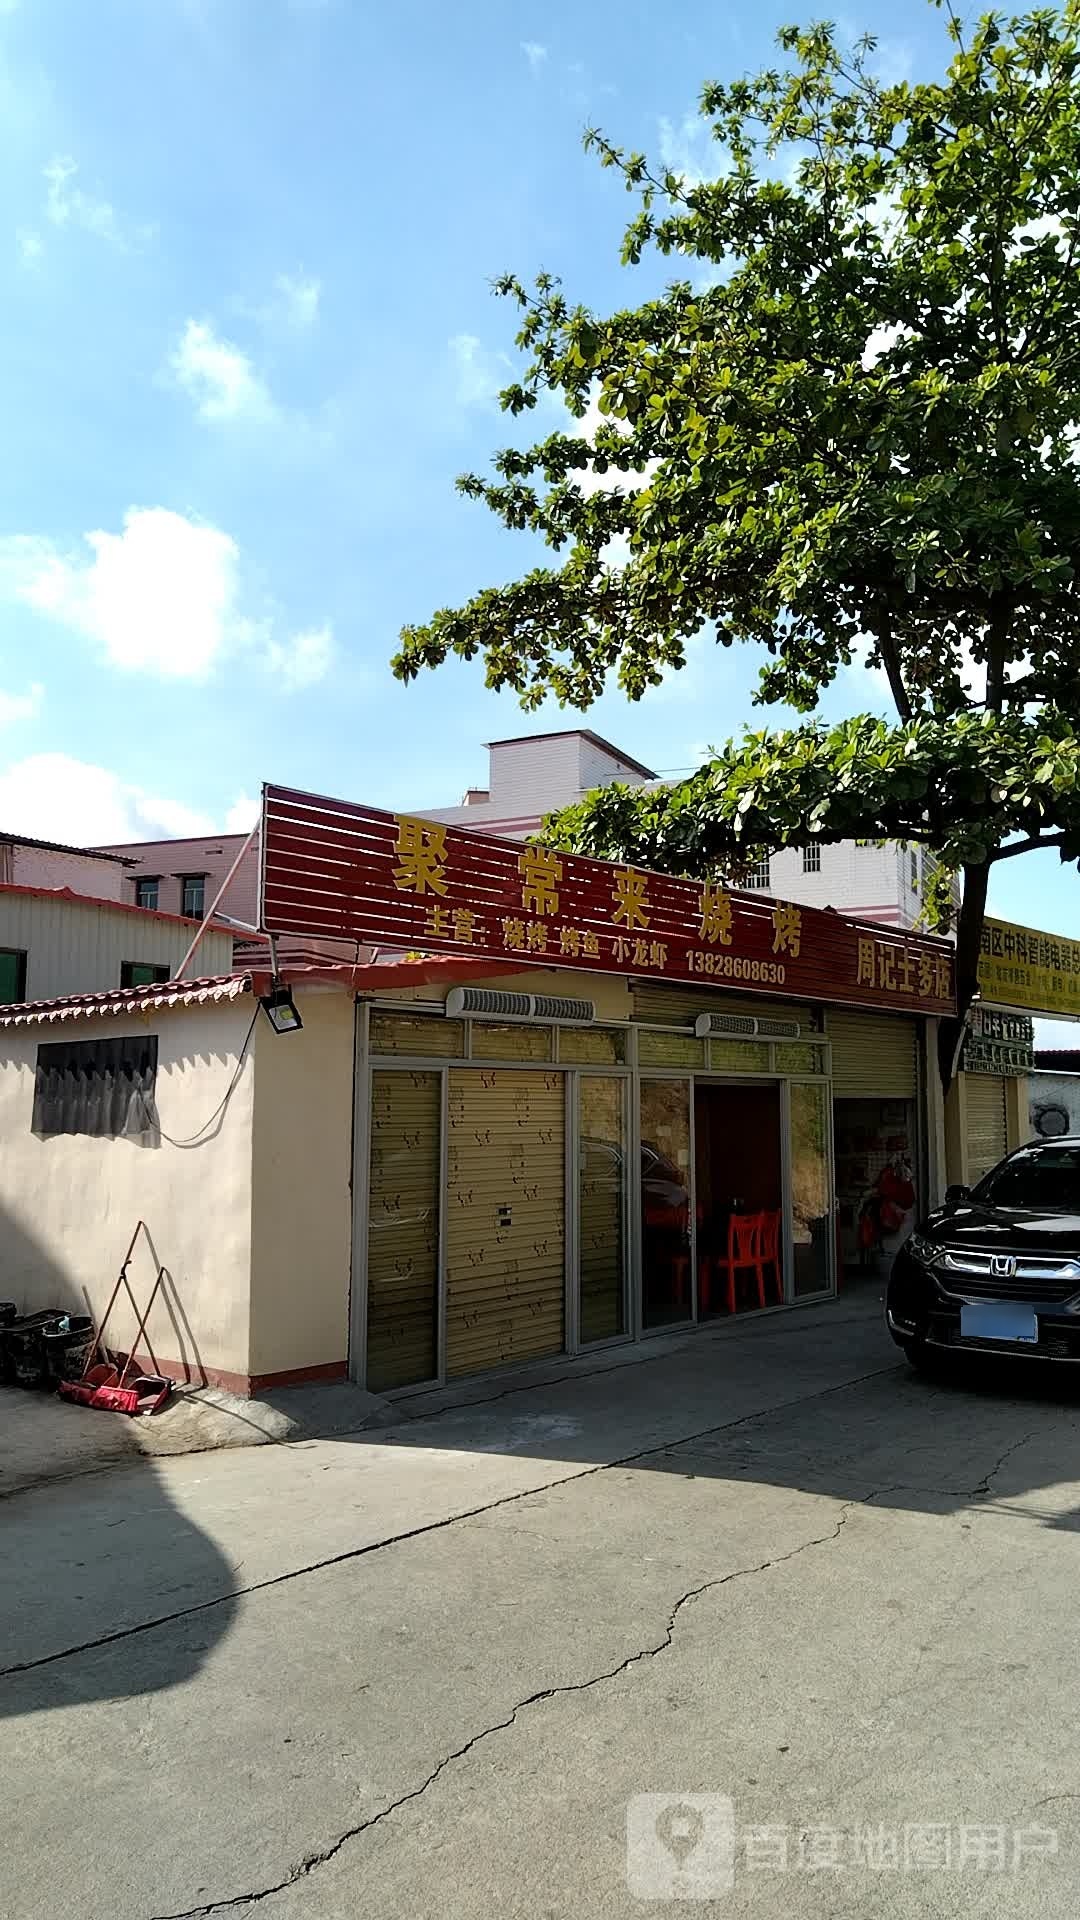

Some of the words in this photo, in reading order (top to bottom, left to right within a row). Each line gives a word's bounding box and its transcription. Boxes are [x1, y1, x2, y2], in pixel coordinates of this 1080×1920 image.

[393, 815, 803, 958] 聚常来烧烤
[502, 915, 549, 953] 烧烤
[559, 925, 602, 960] 烤鱼
[611, 935, 668, 970] 小龙虾
[685, 949, 787, 986] 13828608630
